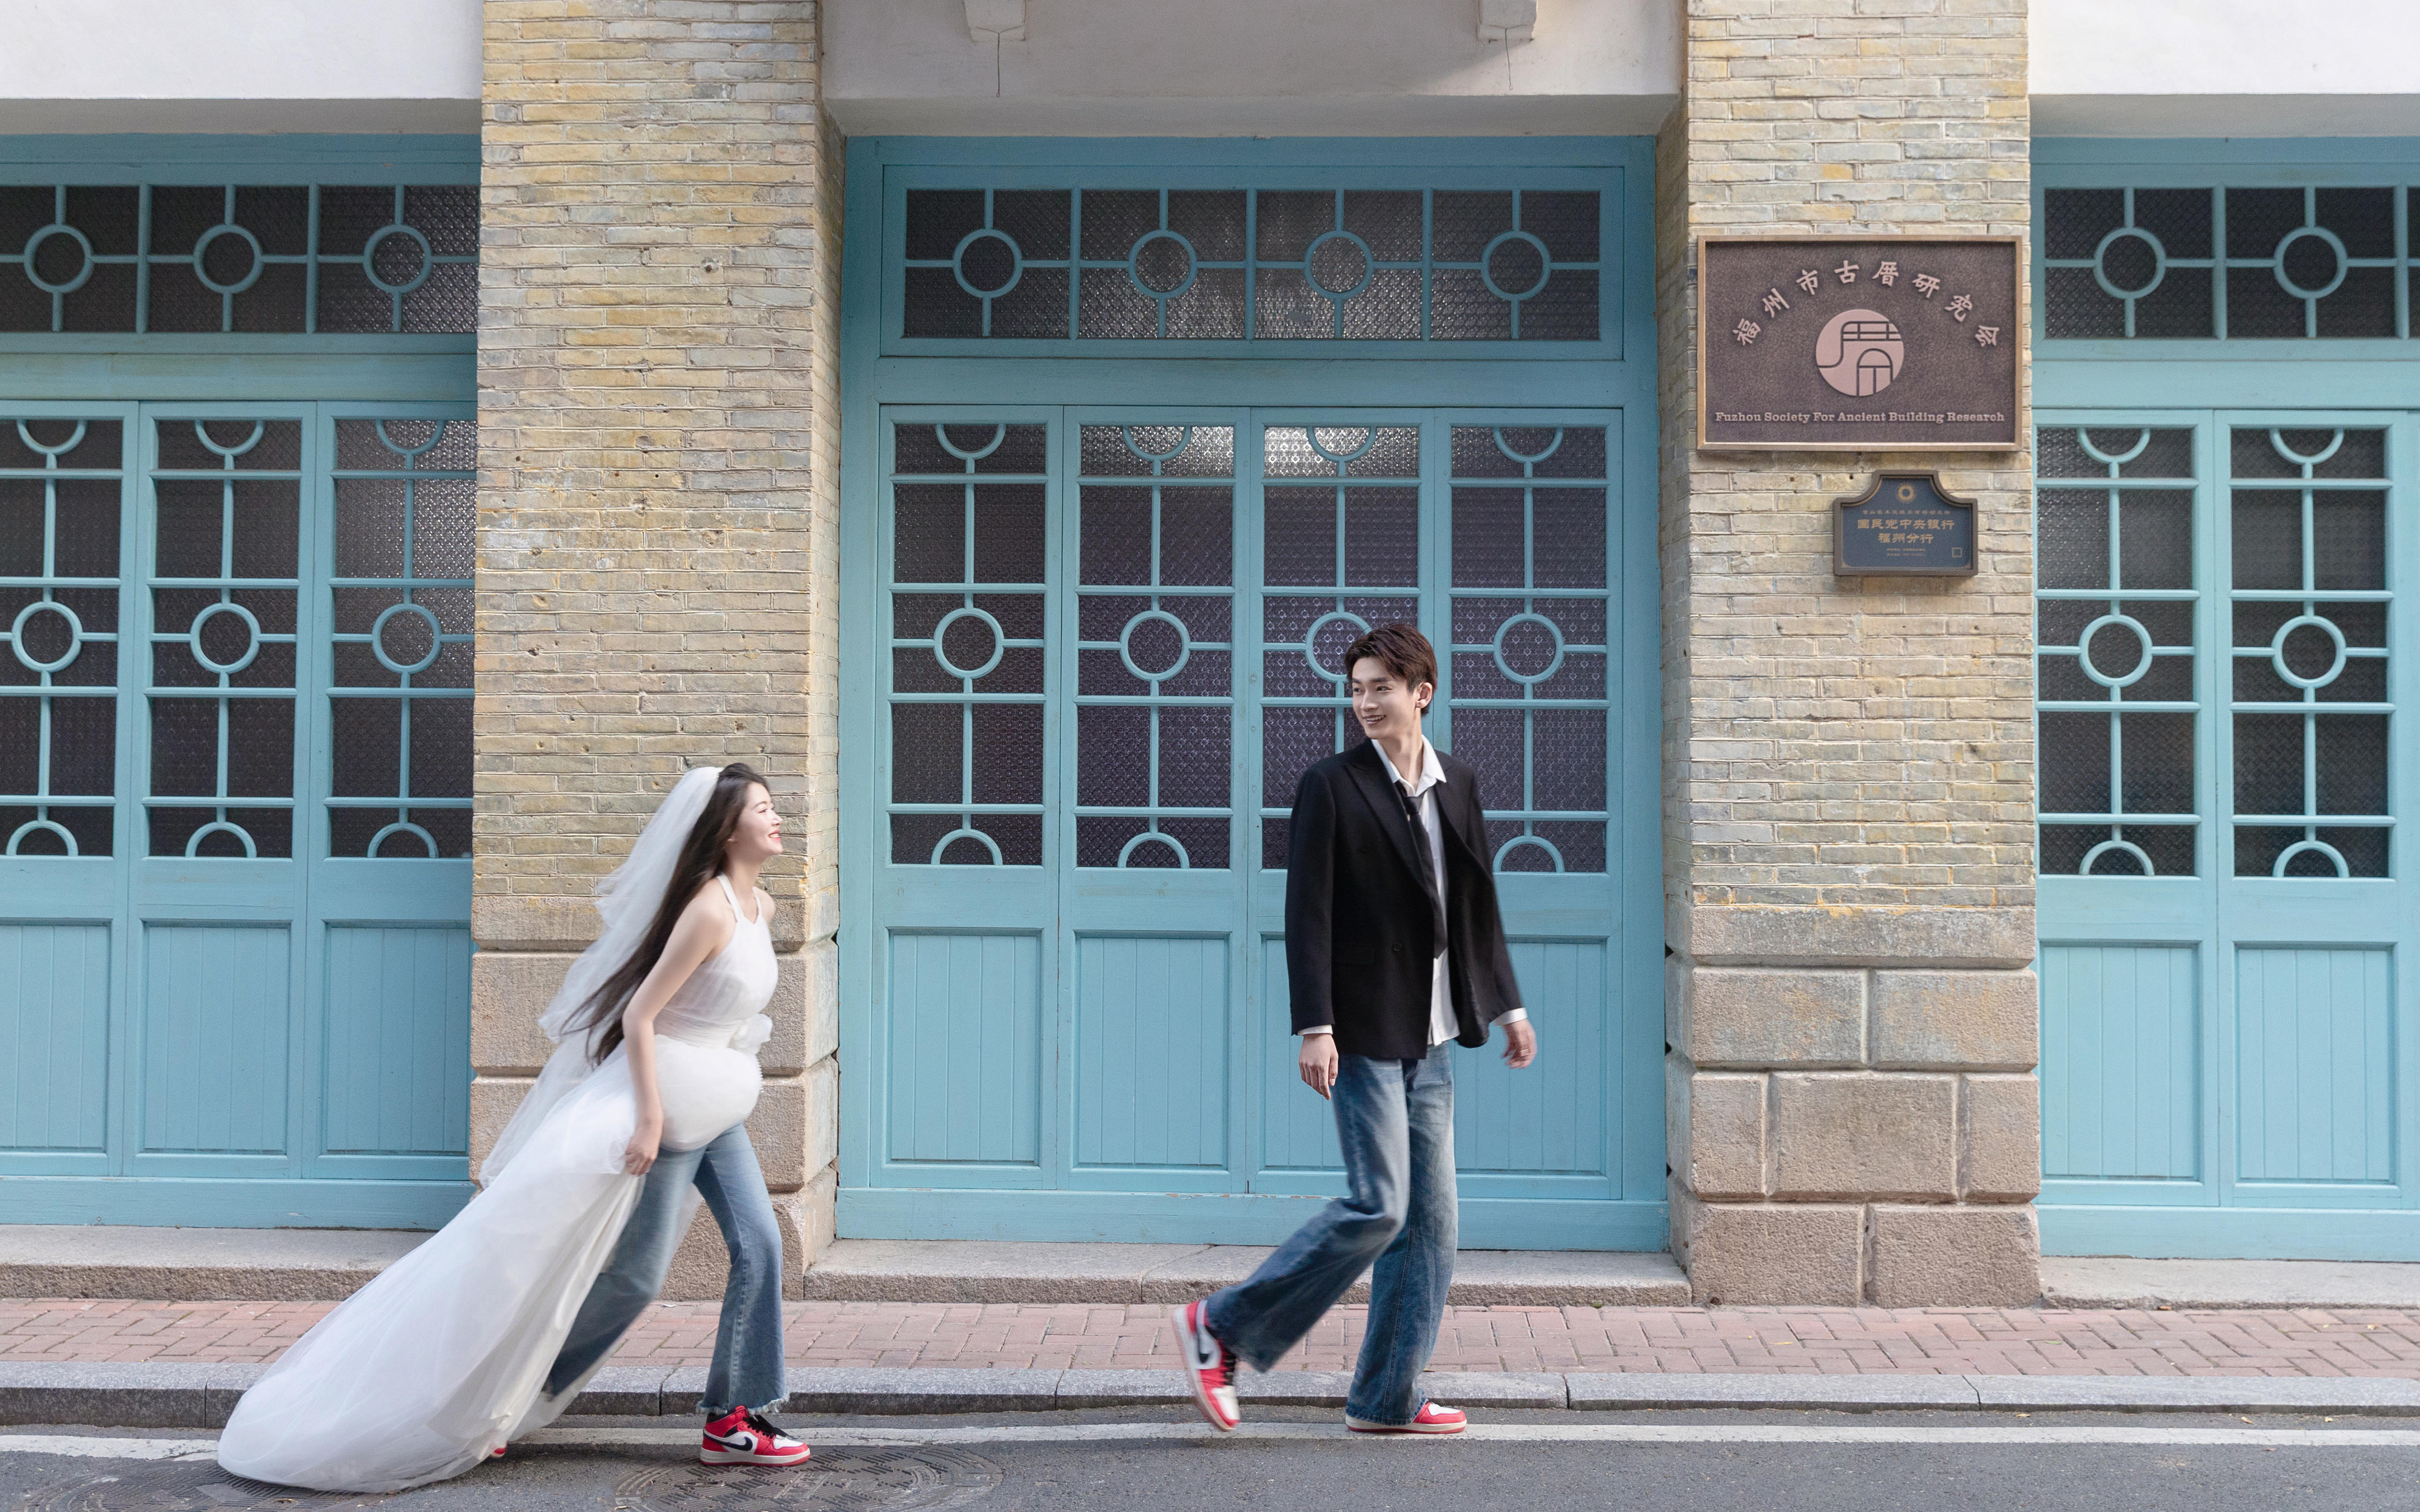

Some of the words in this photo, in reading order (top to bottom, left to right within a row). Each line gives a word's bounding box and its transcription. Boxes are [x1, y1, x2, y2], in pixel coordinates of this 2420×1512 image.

[1732, 260, 2000, 347] 福州市古厝研究会
[1715, 412, 1761, 421] Fuzhou
[1764, 412, 1810, 424] Society
[1813, 412, 1835, 421] For
[1837, 412, 1886, 421] Ancient
[1888, 412, 1945, 424] Building
[1947, 412, 2005, 421] Research
[1878, 533, 1934, 544] 福州分行
